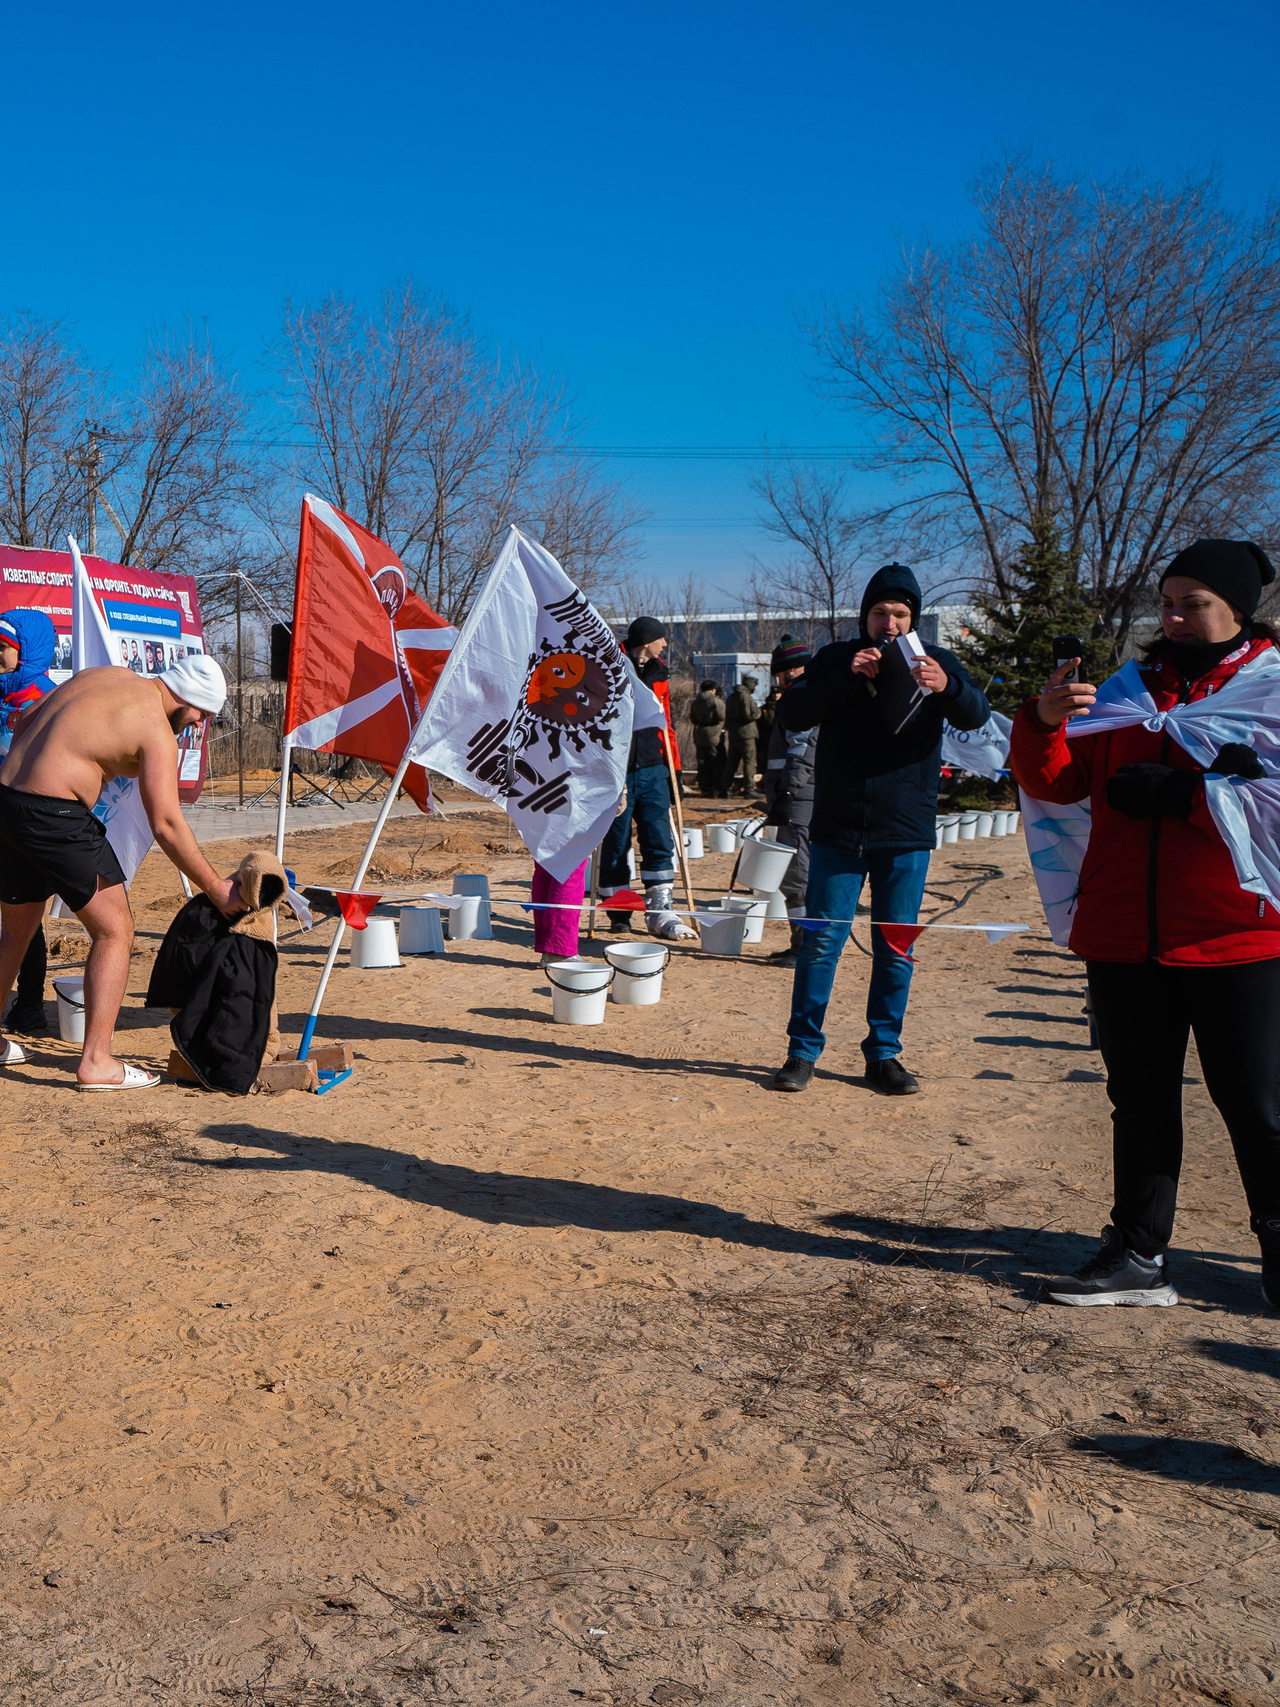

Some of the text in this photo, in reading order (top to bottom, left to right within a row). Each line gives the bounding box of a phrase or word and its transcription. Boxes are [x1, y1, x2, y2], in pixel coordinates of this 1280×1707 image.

[2, 567, 46, 585] ИЗВЕСТНЫЕ
[46, 571, 95, 590] СПОРТСЫ
[93, 577, 105, 591] НА
